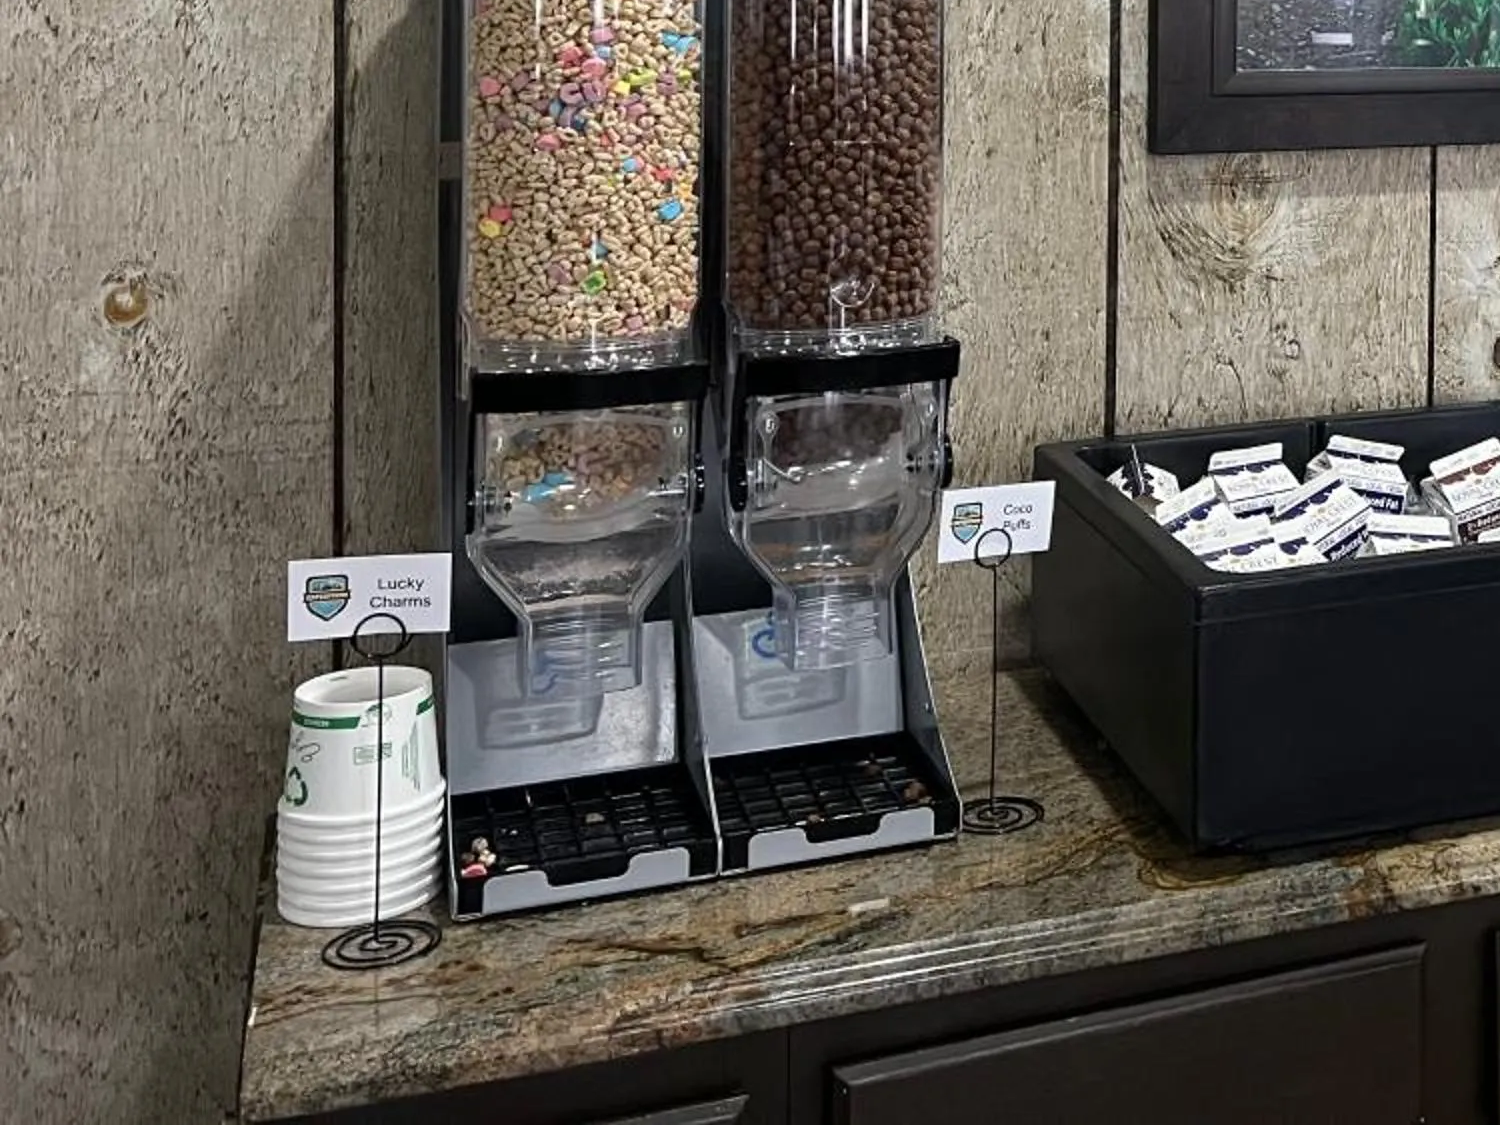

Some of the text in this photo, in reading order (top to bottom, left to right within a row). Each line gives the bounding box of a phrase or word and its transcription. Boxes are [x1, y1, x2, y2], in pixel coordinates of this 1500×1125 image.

[1003, 503, 1034, 516] Coco
[376, 577, 425, 592] Lucky
[368, 595, 432, 609] Charms
